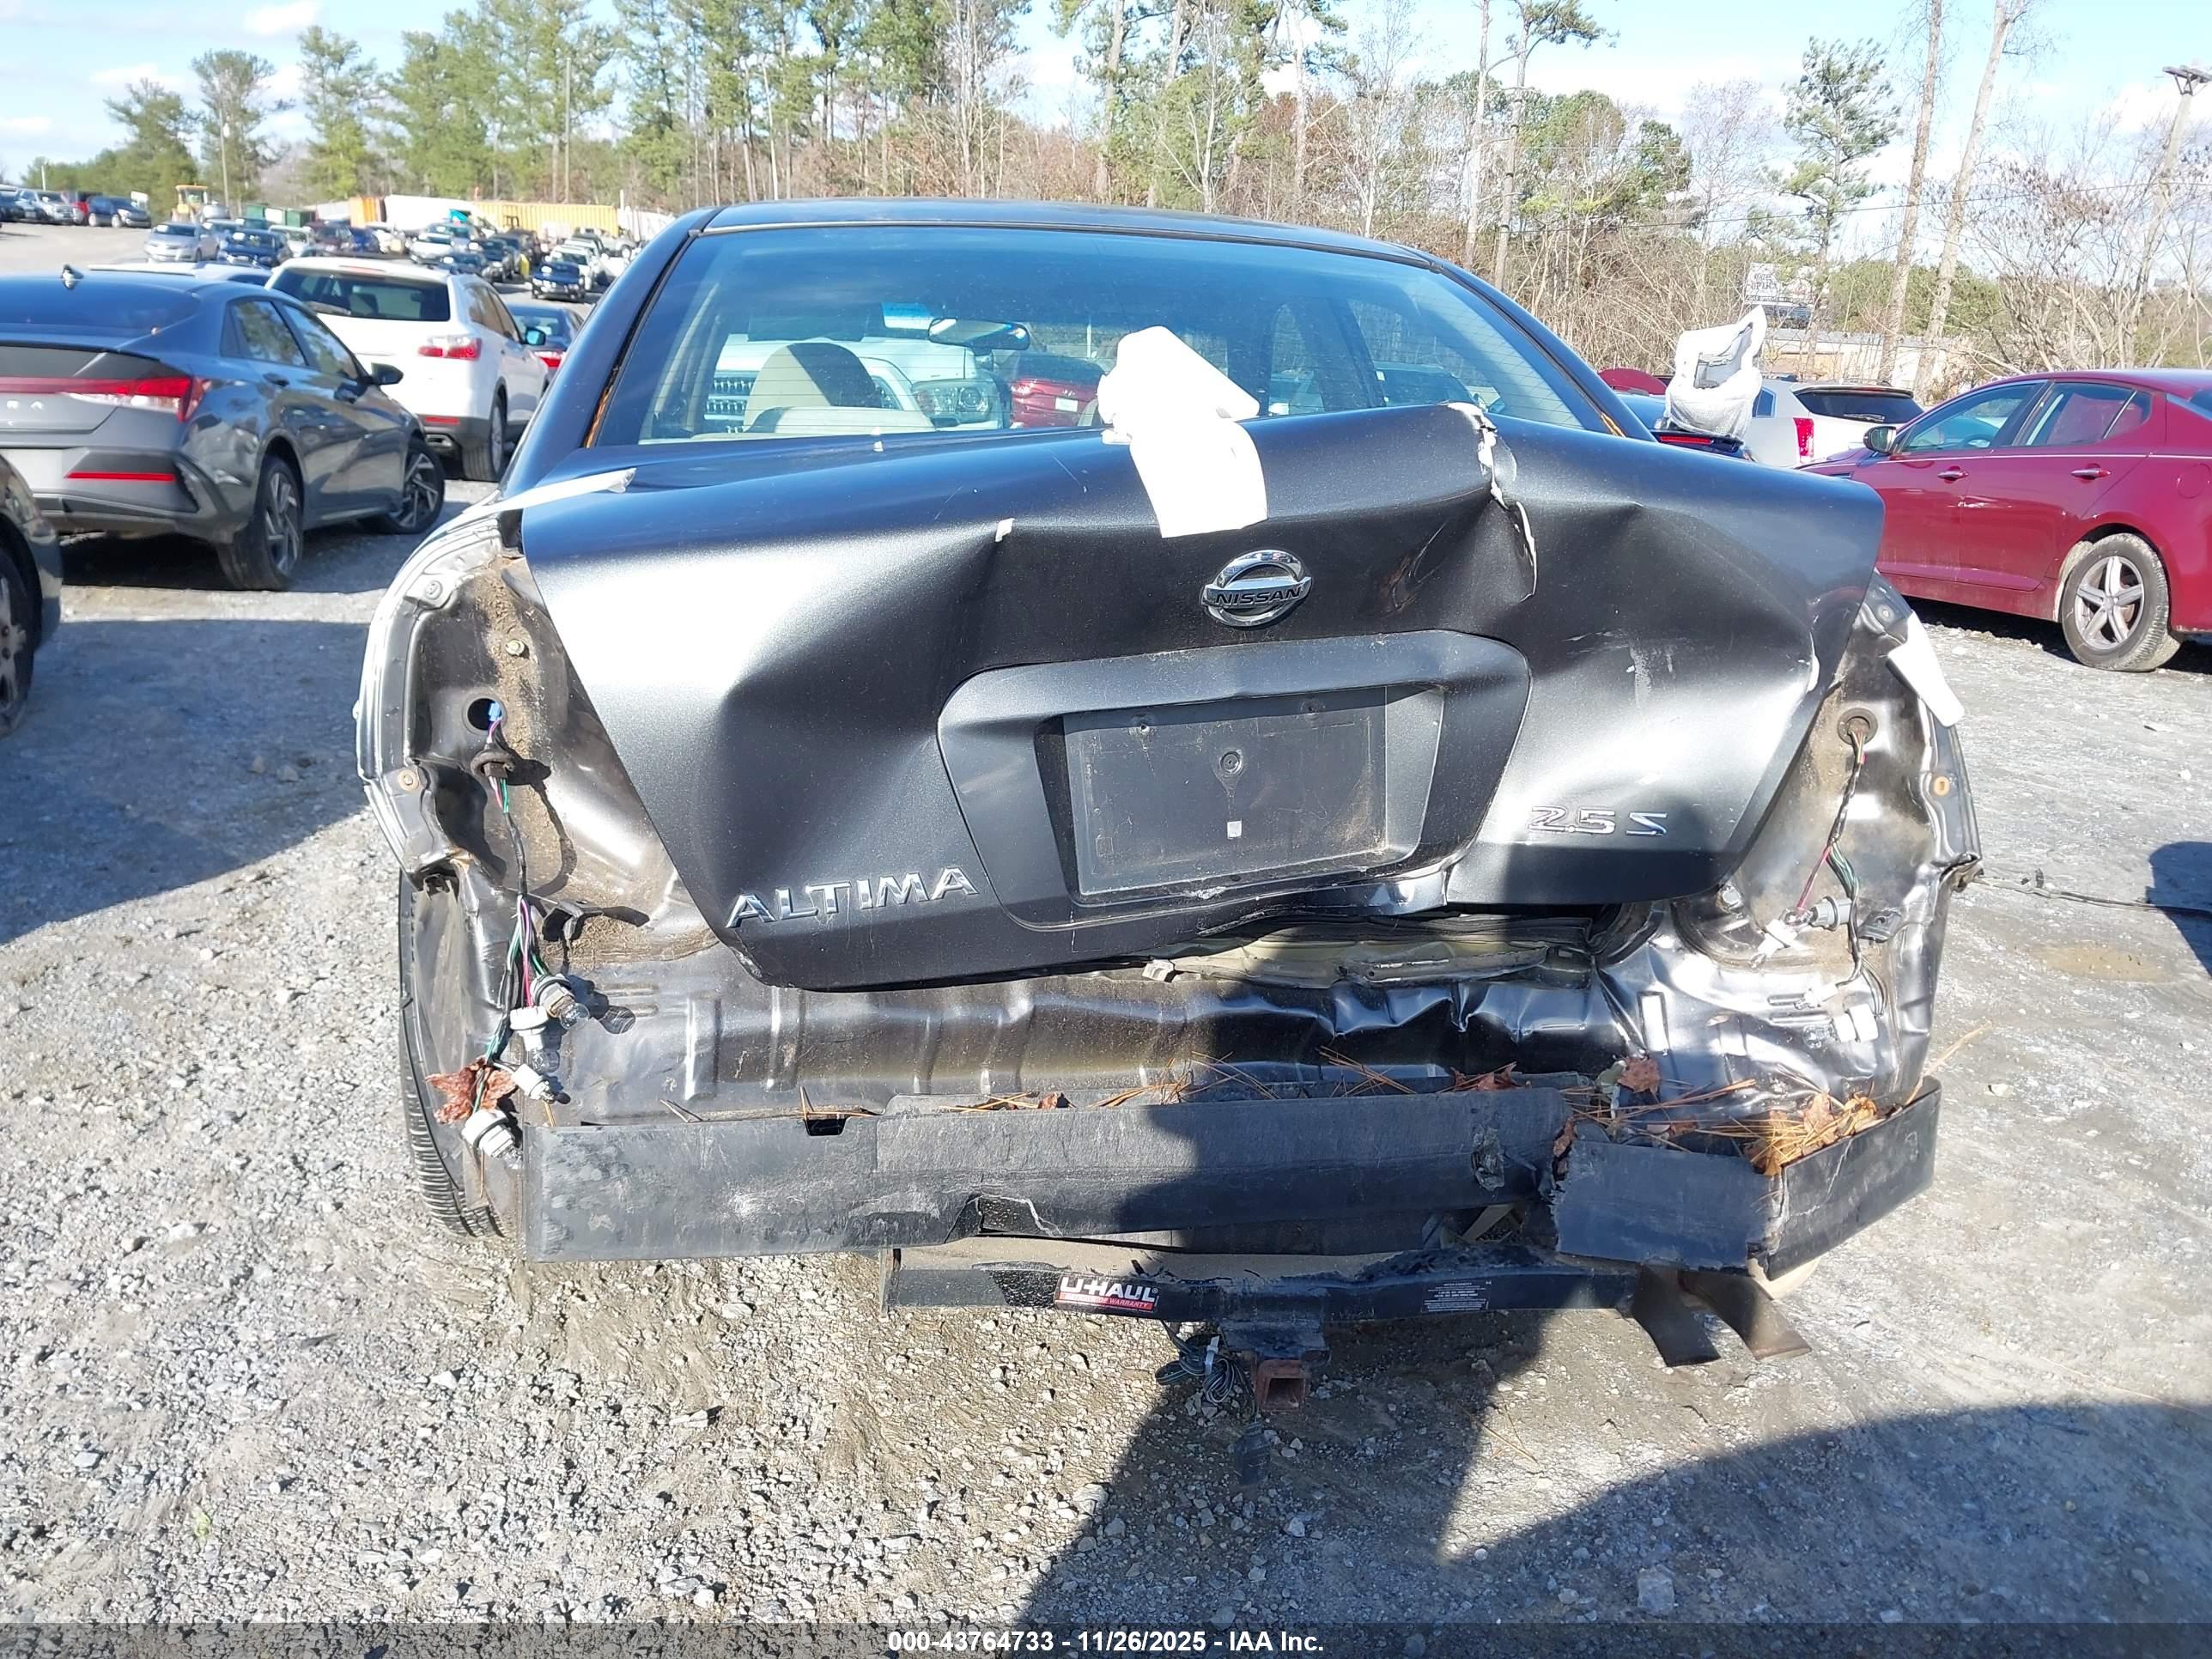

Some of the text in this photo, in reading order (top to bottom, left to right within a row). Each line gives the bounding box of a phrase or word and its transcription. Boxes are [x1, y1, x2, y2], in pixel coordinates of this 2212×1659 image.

[1214, 585, 1303, 605] NISSAN
[1528, 805, 1668, 836] 2.5 S
[725, 866, 980, 928] ALTIMA
[1064, 1293, 1148, 1308] NWIDE WARRANTY
